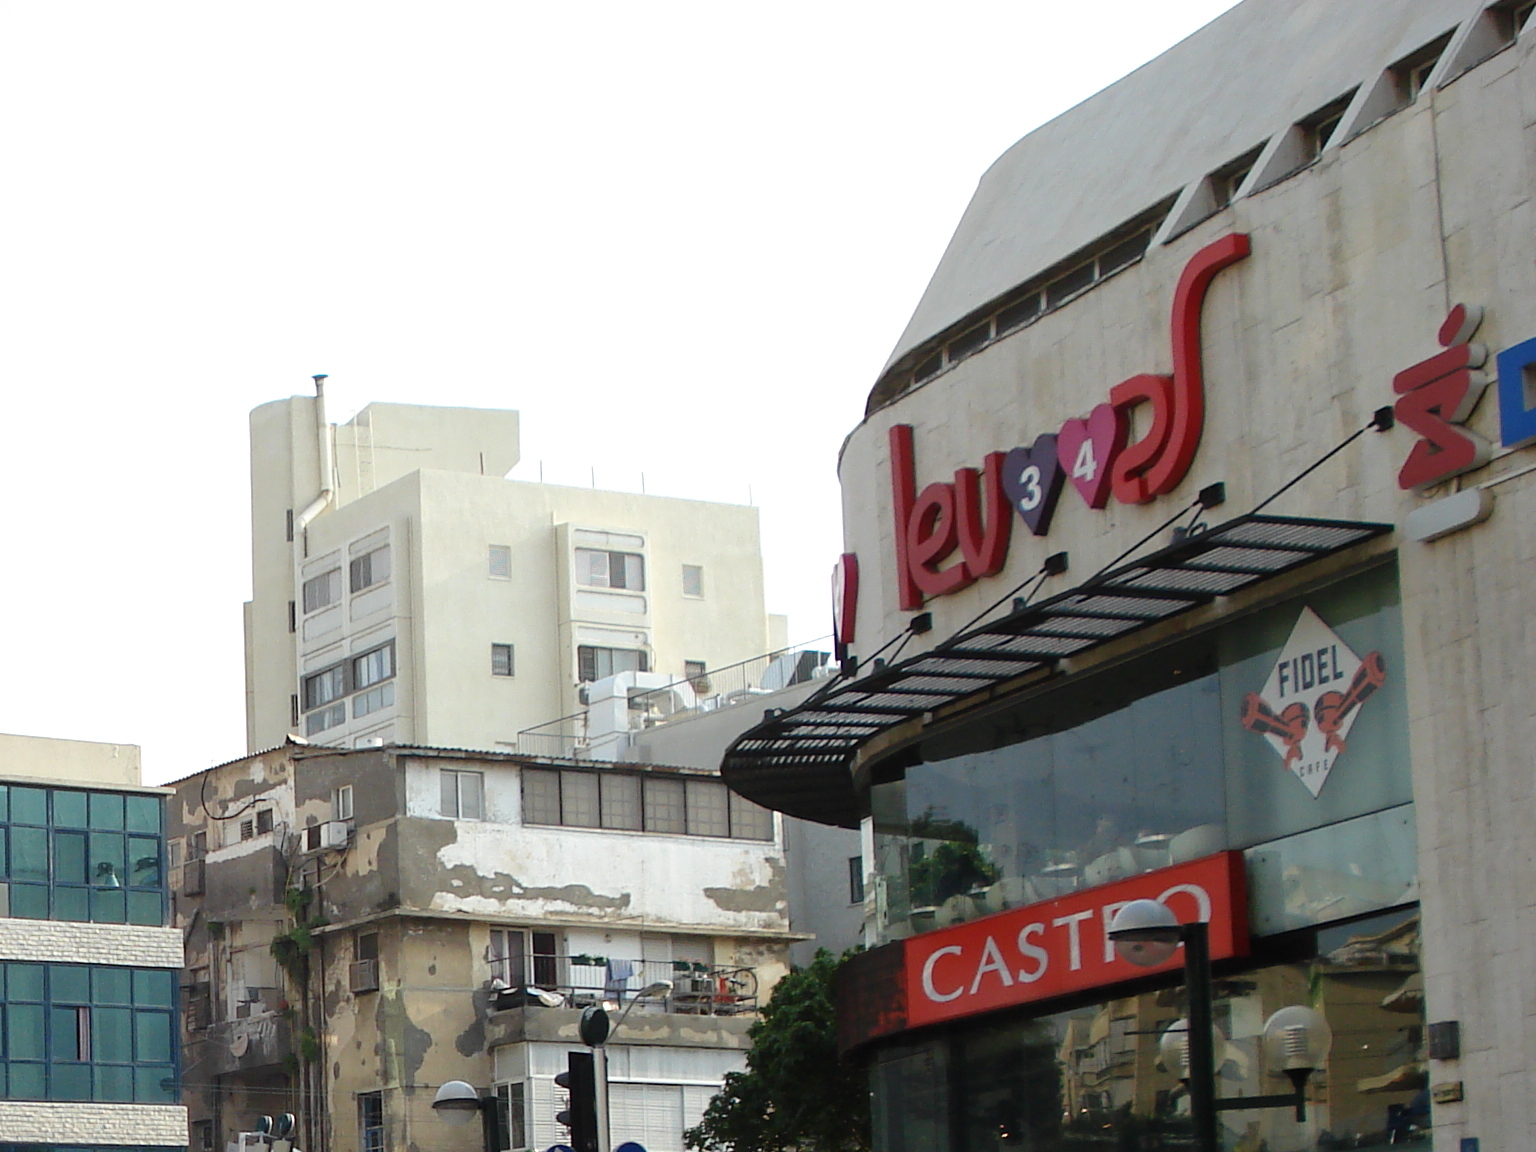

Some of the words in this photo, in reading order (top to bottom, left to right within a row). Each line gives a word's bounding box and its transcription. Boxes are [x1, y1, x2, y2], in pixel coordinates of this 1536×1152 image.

[1072, 437, 1098, 482] 4
[1018, 464, 1043, 512] 3
[890, 423, 1013, 612] lev
[1278, 644, 1344, 698] FIDEL
[1299, 759, 1329, 777] CAFE
